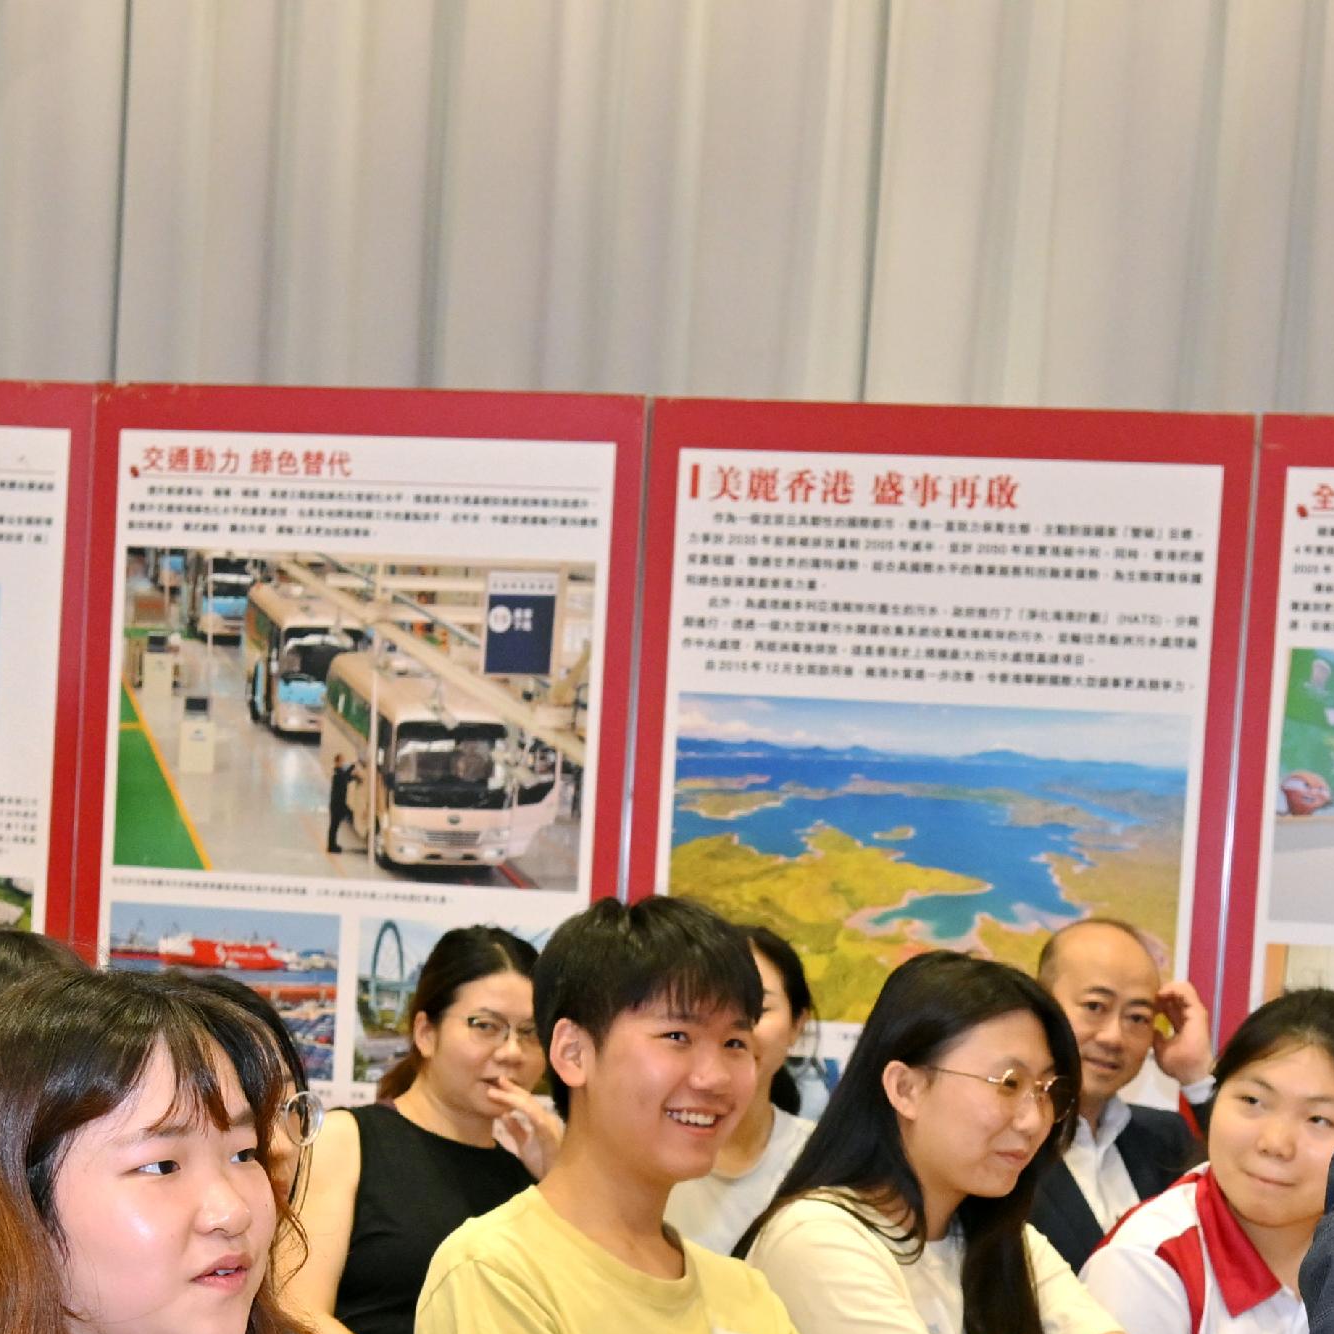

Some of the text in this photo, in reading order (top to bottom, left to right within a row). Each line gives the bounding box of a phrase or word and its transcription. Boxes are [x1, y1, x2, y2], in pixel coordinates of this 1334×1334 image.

[141, 446, 353, 477] 交通動力 綠色替代
[708, 465, 1020, 510] 美麗香港 盛事再啟
